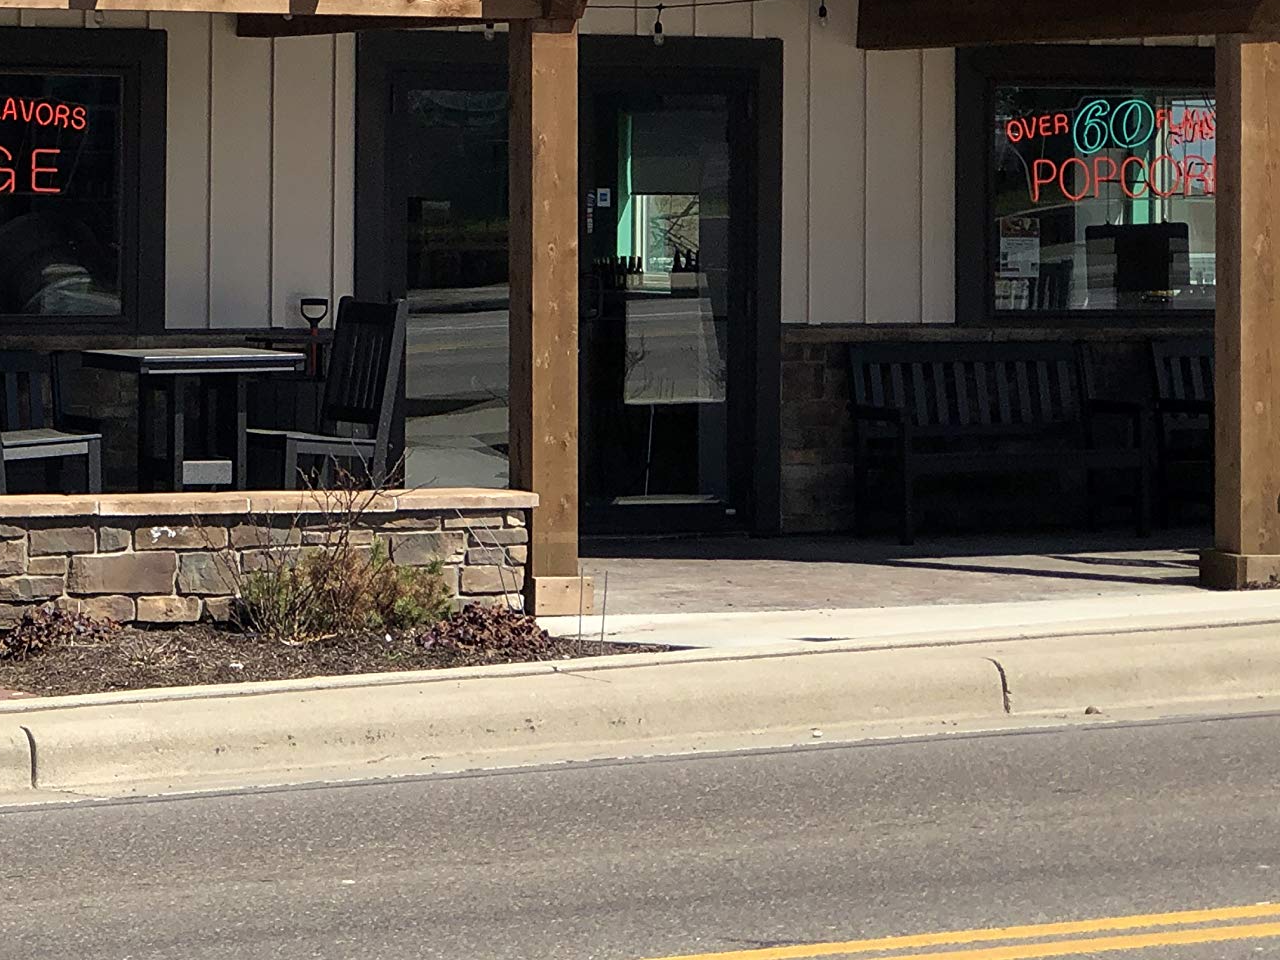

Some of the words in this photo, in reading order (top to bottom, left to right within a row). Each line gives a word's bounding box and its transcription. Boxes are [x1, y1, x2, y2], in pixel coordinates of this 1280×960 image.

[1006, 113, 1069, 143] OVER
[1072, 99, 1156, 155] 60
[1031, 155, 1216, 202] POPCOR
